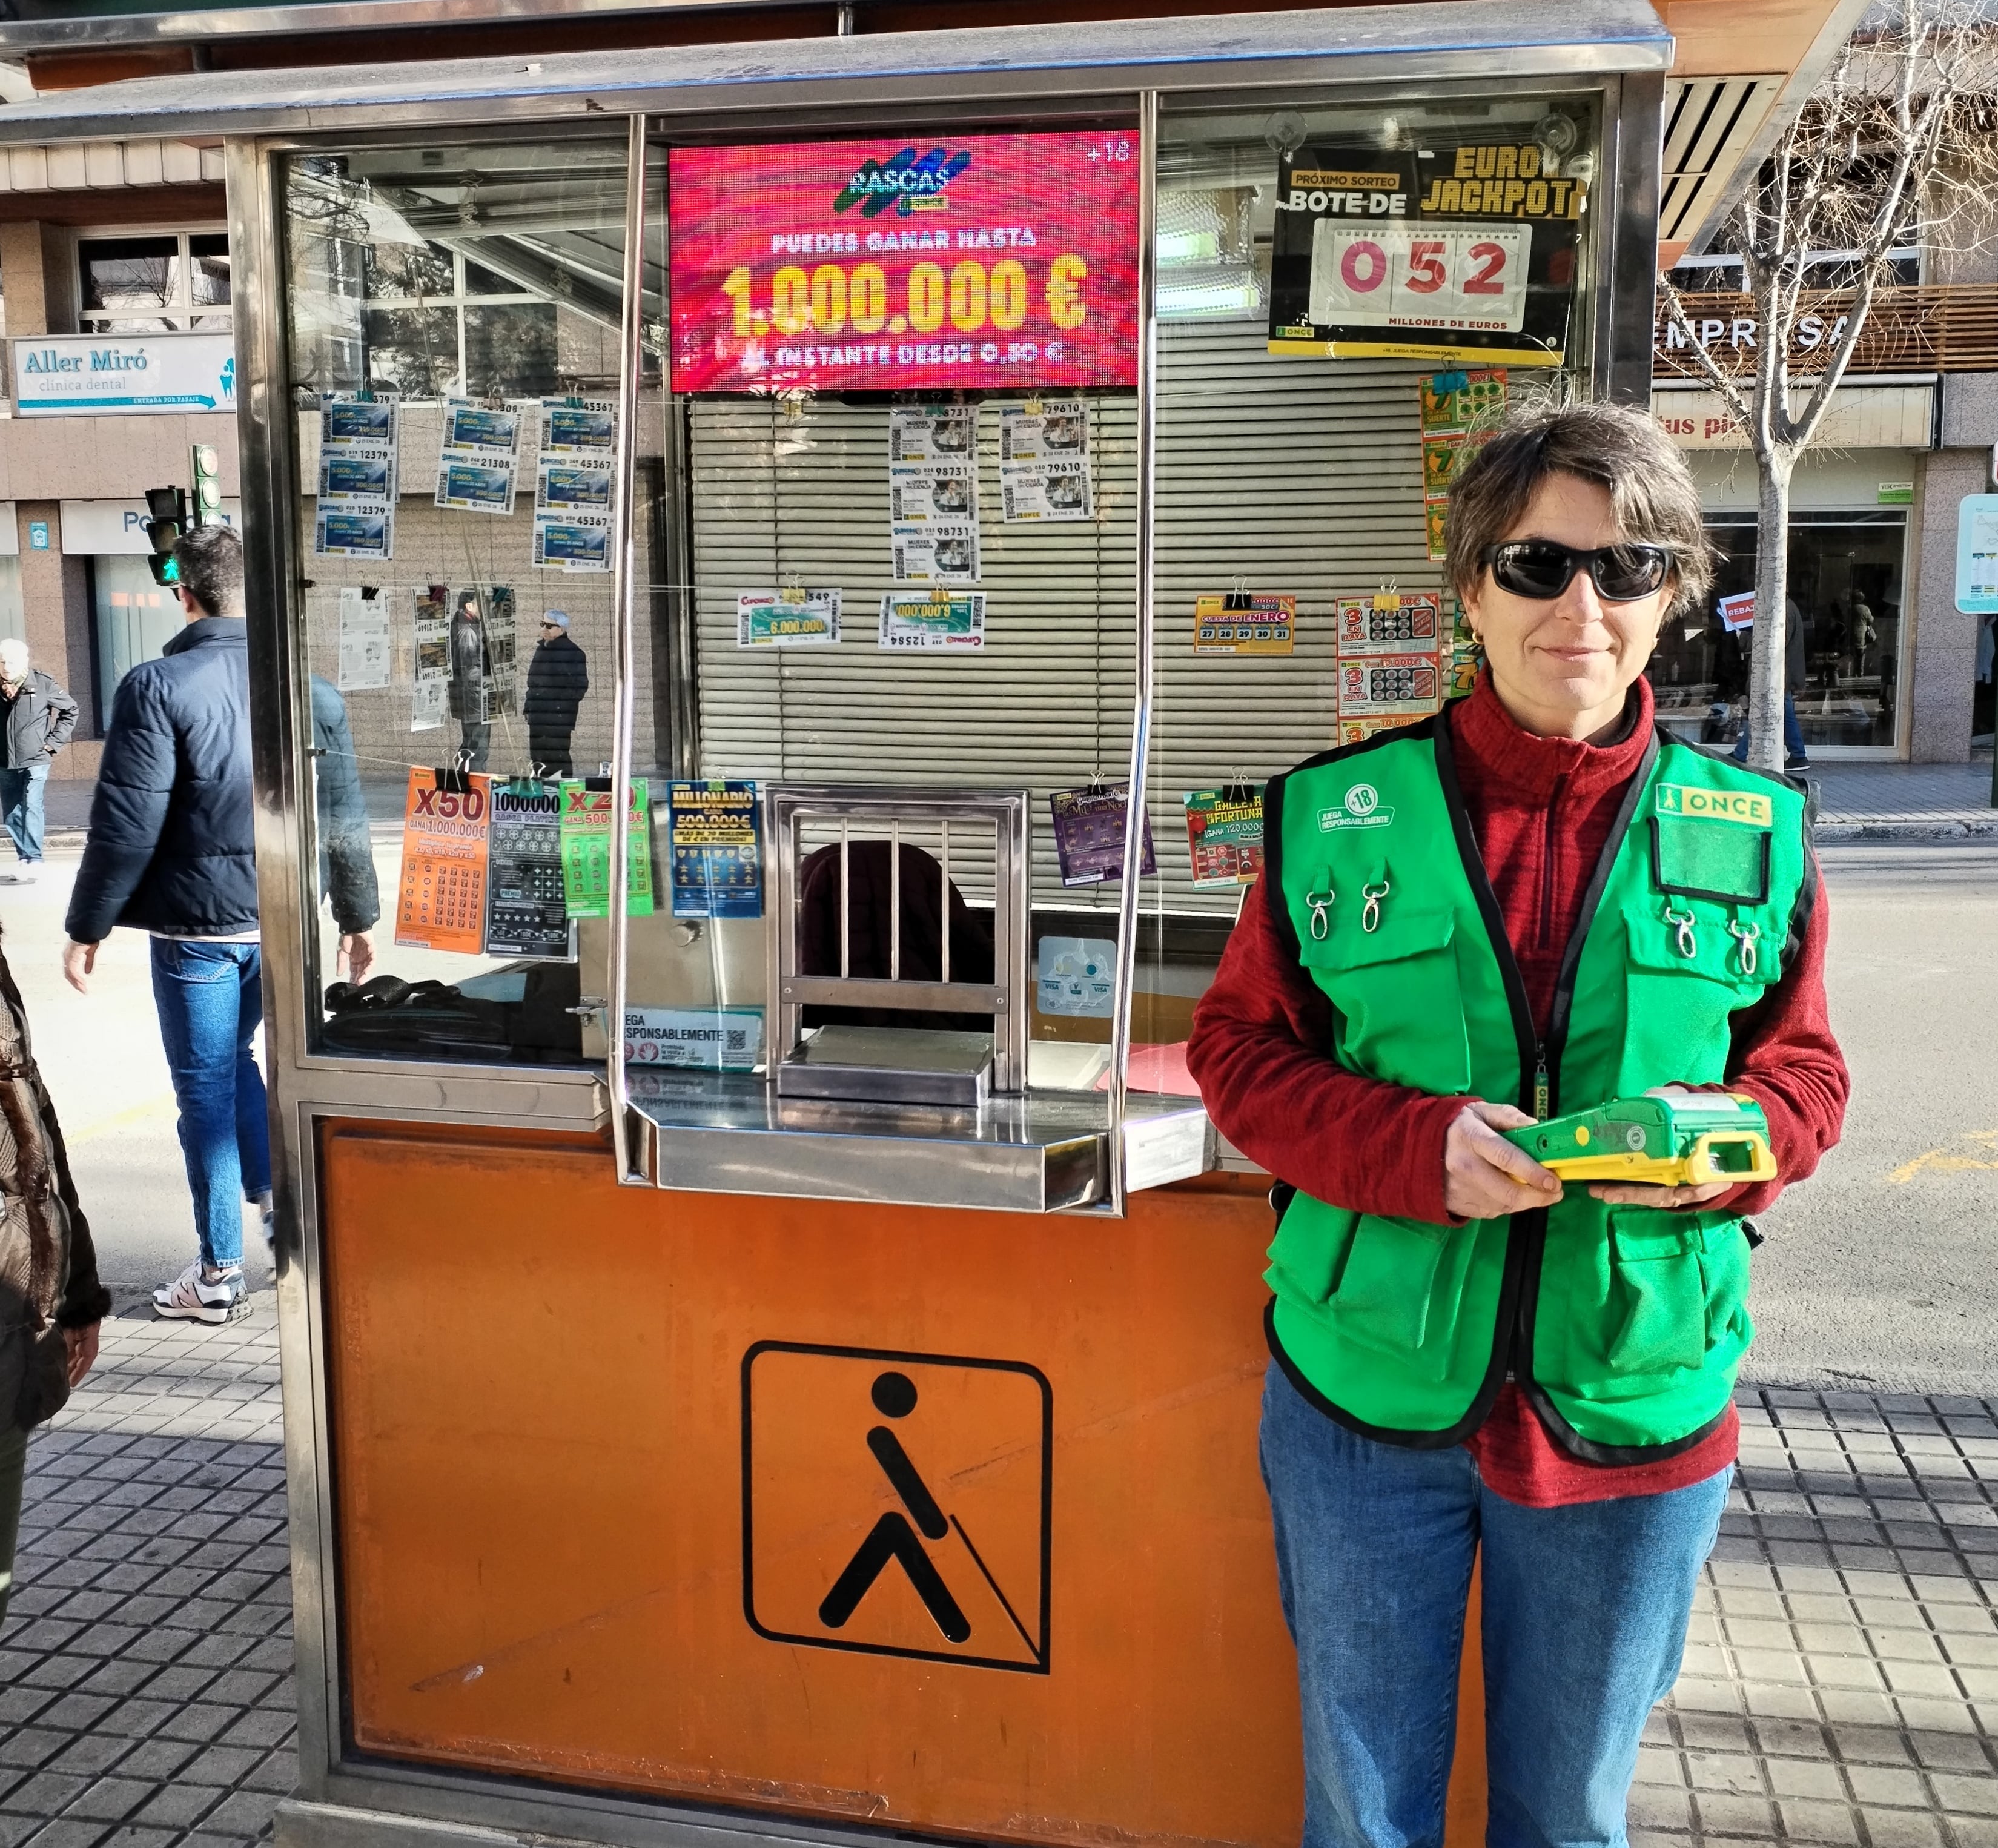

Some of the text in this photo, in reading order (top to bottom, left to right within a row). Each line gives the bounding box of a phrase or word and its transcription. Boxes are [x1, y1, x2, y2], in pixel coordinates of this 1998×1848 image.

[1087, 140, 1130, 162] +18
[1454, 145, 1540, 179] EURO
[1296, 173, 1397, 187] PRÓXIMO SORTEO
[1289, 190, 1406, 214] BOTE DE
[1420, 179, 1573, 216] JACKPOT
[770, 227, 1037, 253] PUEDES GANAR HASTA
[722, 253, 1088, 337] 1.000.000 €
[1389, 317, 1507, 330] MILLONES DE EUROS
[1287, 328, 1312, 337] ONCE
[24, 348, 148, 373] Aller Miró
[776, 343, 890, 367] INSTANTE
[898, 342, 972, 365] DESDE
[39, 377, 127, 392] clínica dental
[584, 402, 614, 412] 45367
[944, 408, 969, 417] 8731
[1047, 403, 1079, 414] 79610
[360, 450, 388, 460] 12379
[1434, 449, 1453, 472] 7
[481, 458, 510, 469] 21308
[580, 459, 611, 470] 45367
[1047, 462, 1080, 473] 79610
[936, 467, 967, 476] 98731
[357, 505, 385, 515] 12379
[577, 515, 607, 526] 45367
[937, 527, 968, 536] 98731
[1245, 611, 1291, 622] ENERO
[1344, 608, 1363, 625] 3
[1728, 604, 1754, 617] REBAJ
[891, 636, 925, 646] 12584
[1341, 632, 1366, 641] RAYA
[1380, 658, 1422, 667] 10.000€
[1345, 667, 1363, 686] 3
[1342, 692, 1368, 701] RAYA
[672, 791, 753, 809] MILLONARIO
[1351, 789, 1372, 809] +18
[1690, 793, 1763, 820] ONCE
[585, 812, 643, 824] 500.0€
[676, 814, 751, 829] 500.000€
[1214, 807, 1263, 824] FORTUNA
[1322, 810, 1343, 821] JUEGA
[1322, 815, 1389, 829] RESPONSABLEMENTE
[409, 820, 485, 838] GANA 1.000.000€
[624, 1015, 644, 1026] EGA
[624, 1027, 724, 1041] SPONSABLEMENTE
